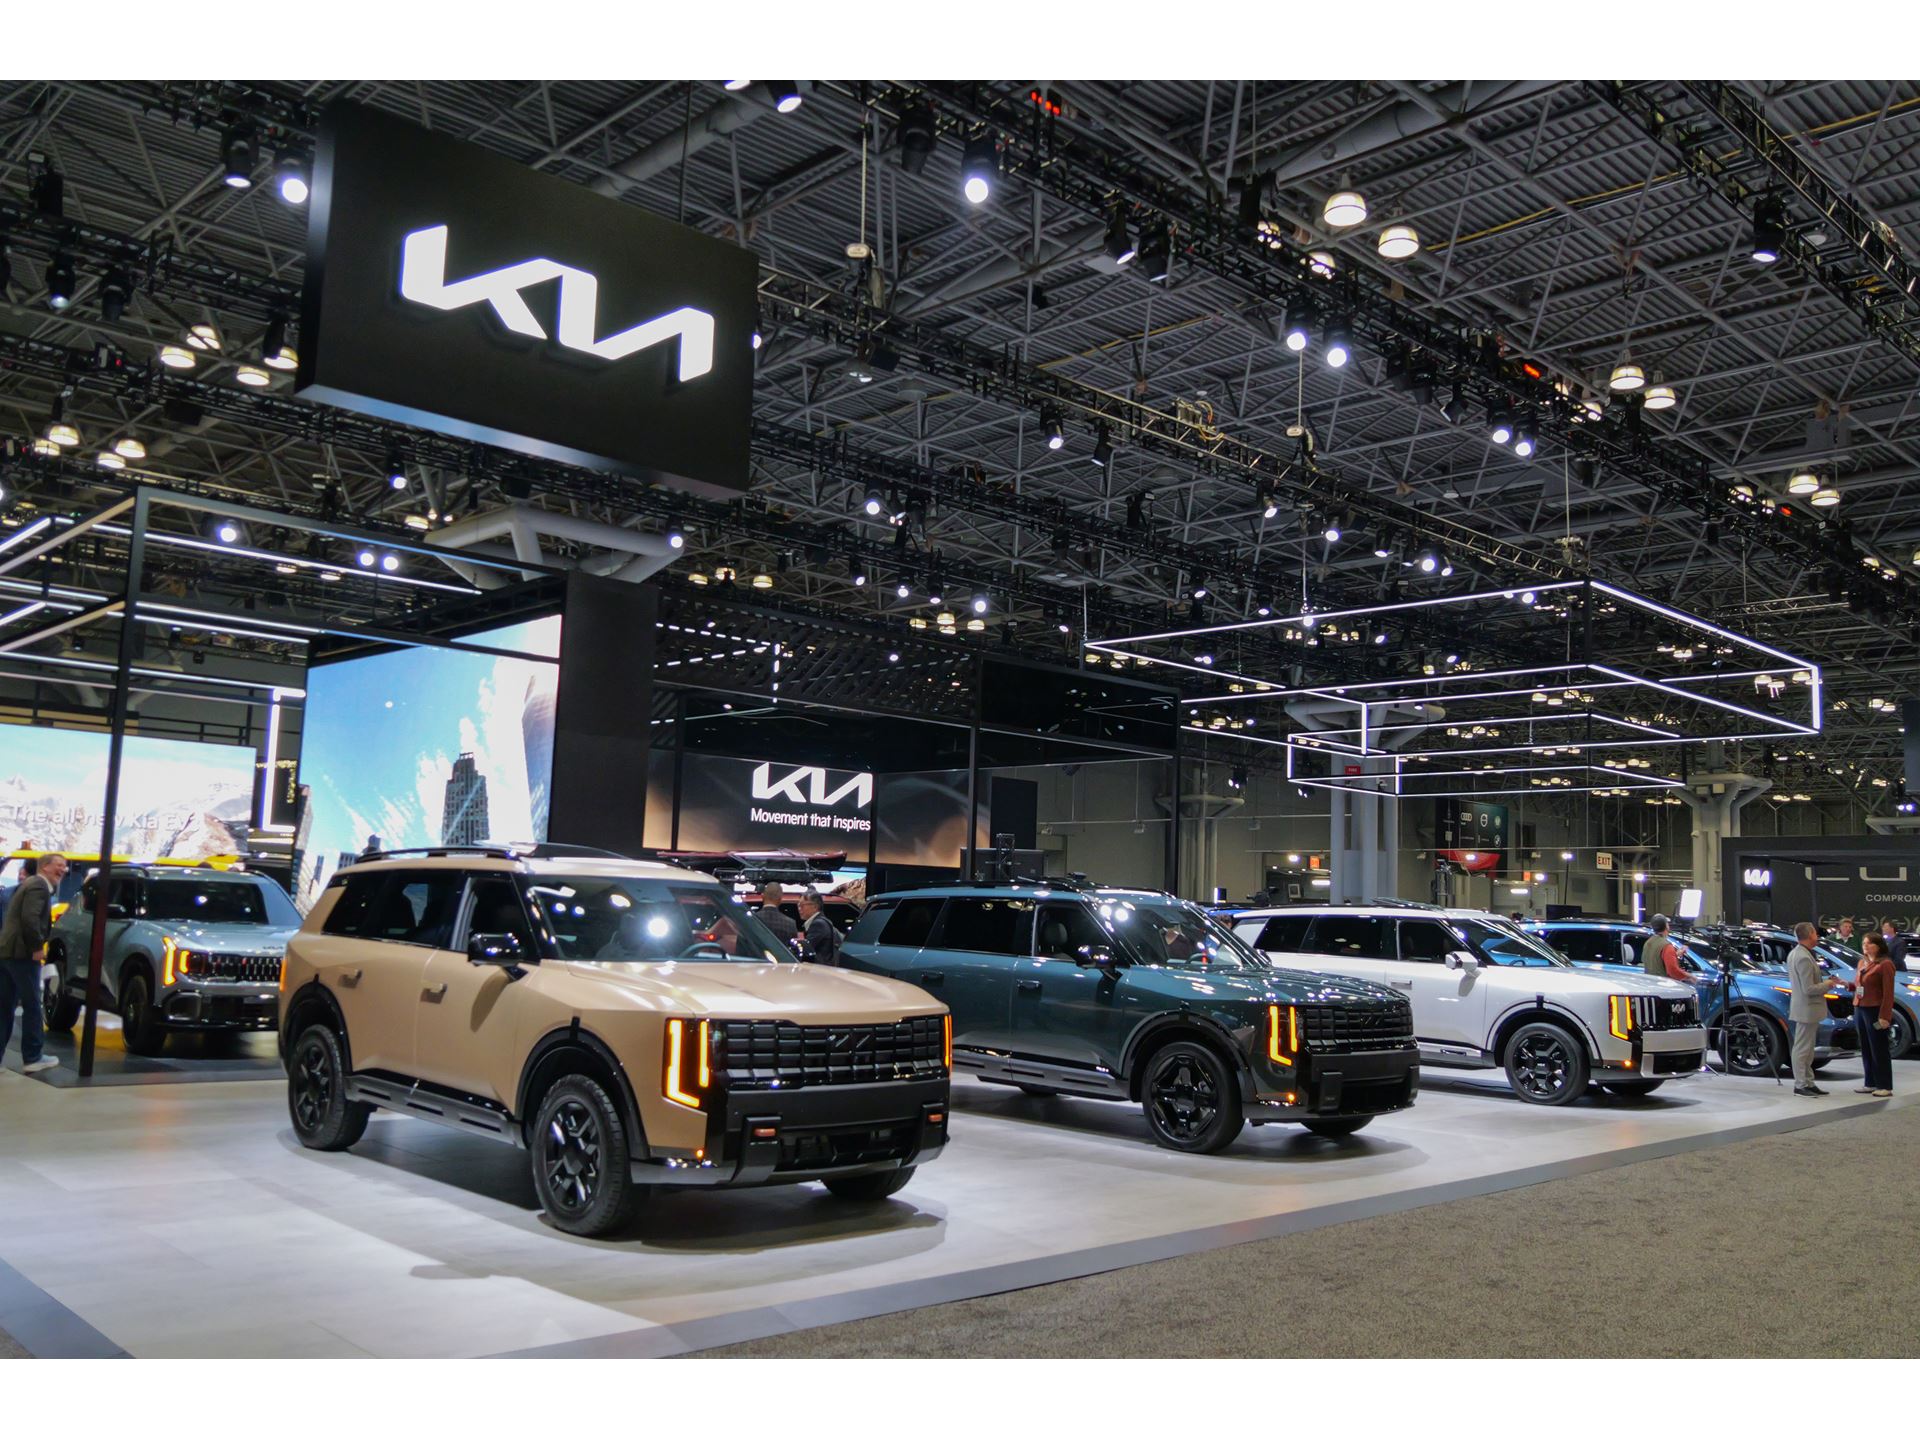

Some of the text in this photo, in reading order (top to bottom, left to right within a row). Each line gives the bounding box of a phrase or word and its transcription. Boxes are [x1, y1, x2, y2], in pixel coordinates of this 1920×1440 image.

[401, 224, 714, 382] KIA
[752, 761, 873, 808] KIA
[11, 804, 48, 824] The
[751, 808, 871, 832] Movement that inspires
[1597, 856, 1610, 866] EXIT
[1744, 868, 1770, 887] KIA
